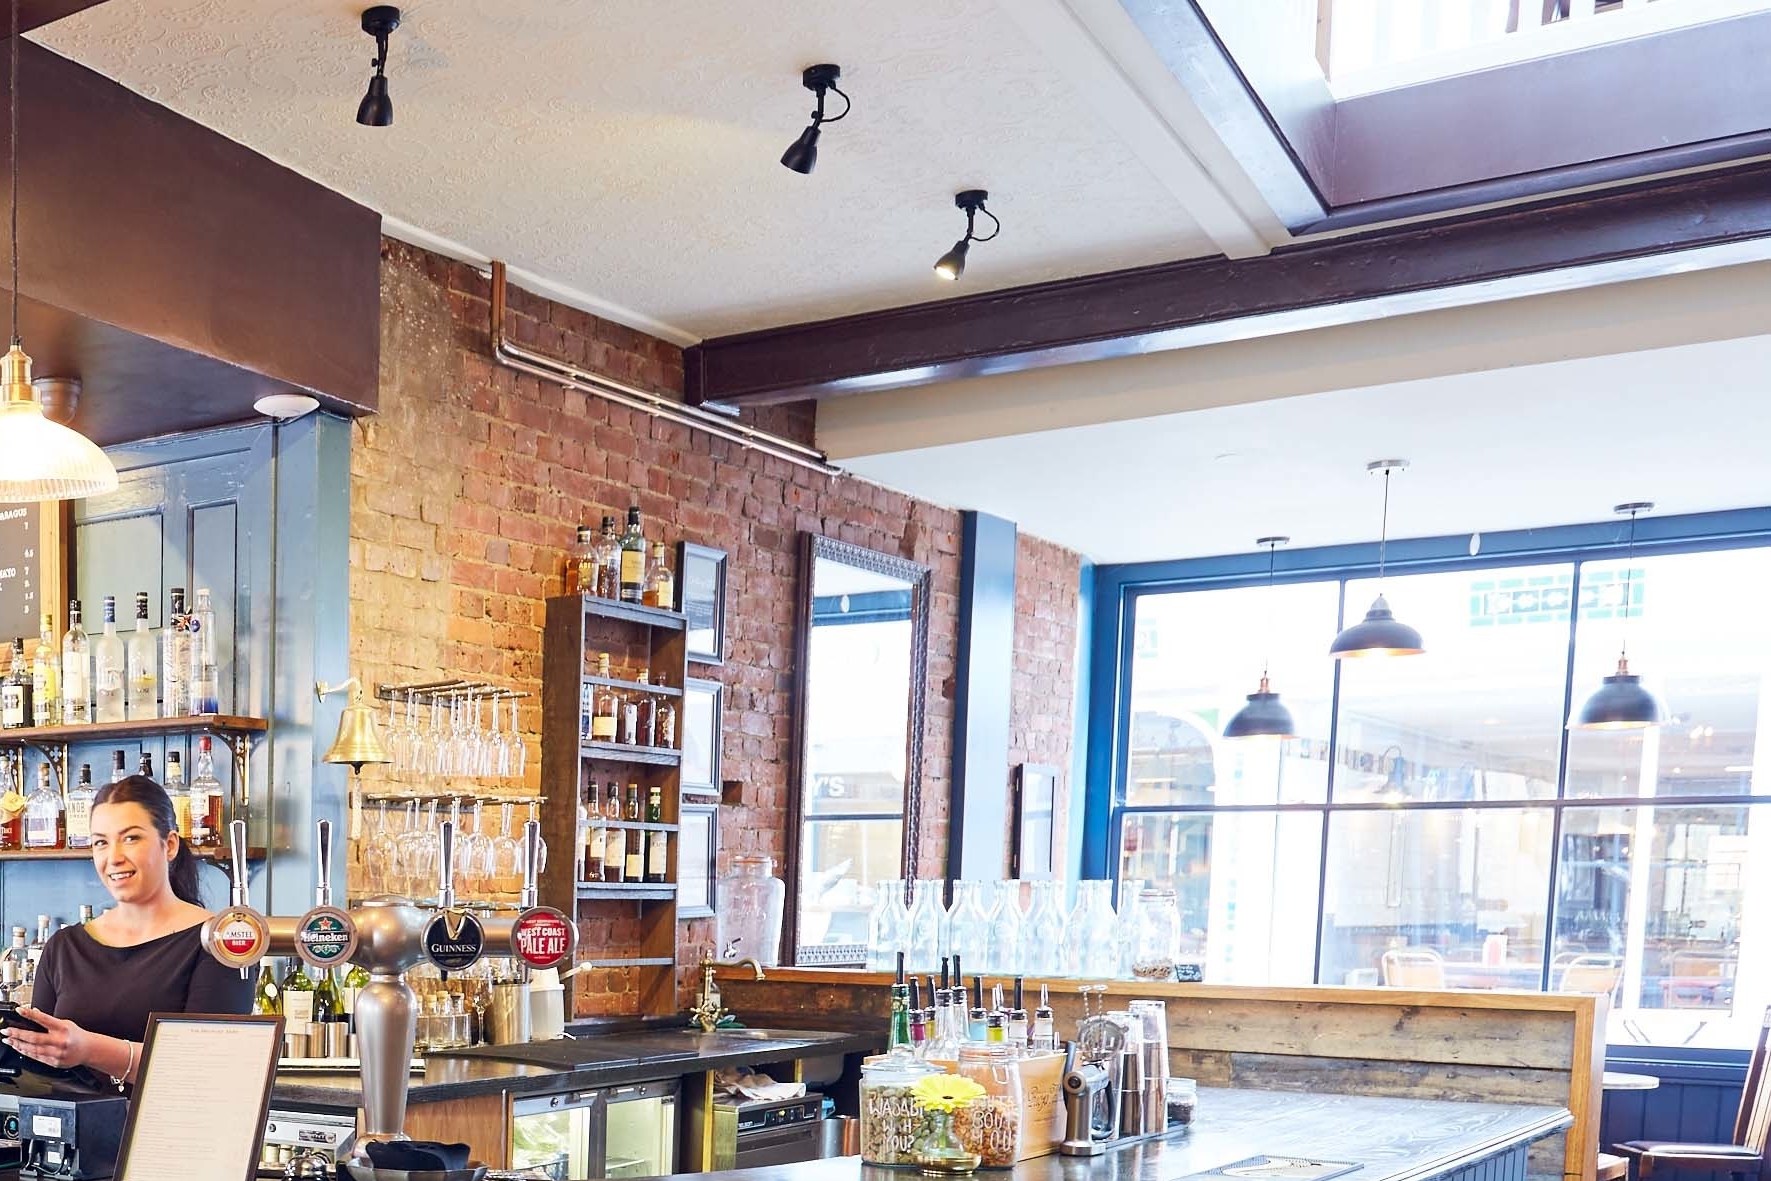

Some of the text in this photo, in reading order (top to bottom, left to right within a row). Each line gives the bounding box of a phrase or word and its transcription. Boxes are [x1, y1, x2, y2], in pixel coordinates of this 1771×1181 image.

[303, 931, 348, 943] Heineken
[520, 926, 565, 938] WEST COAST
[431, 943, 477, 953] GUINNESS
[520, 937, 565, 954] PALE ALE
[869, 1096, 924, 1118] WASABI
[883, 1135, 915, 1154] YOU?
[972, 1128, 1013, 1152] YOU
